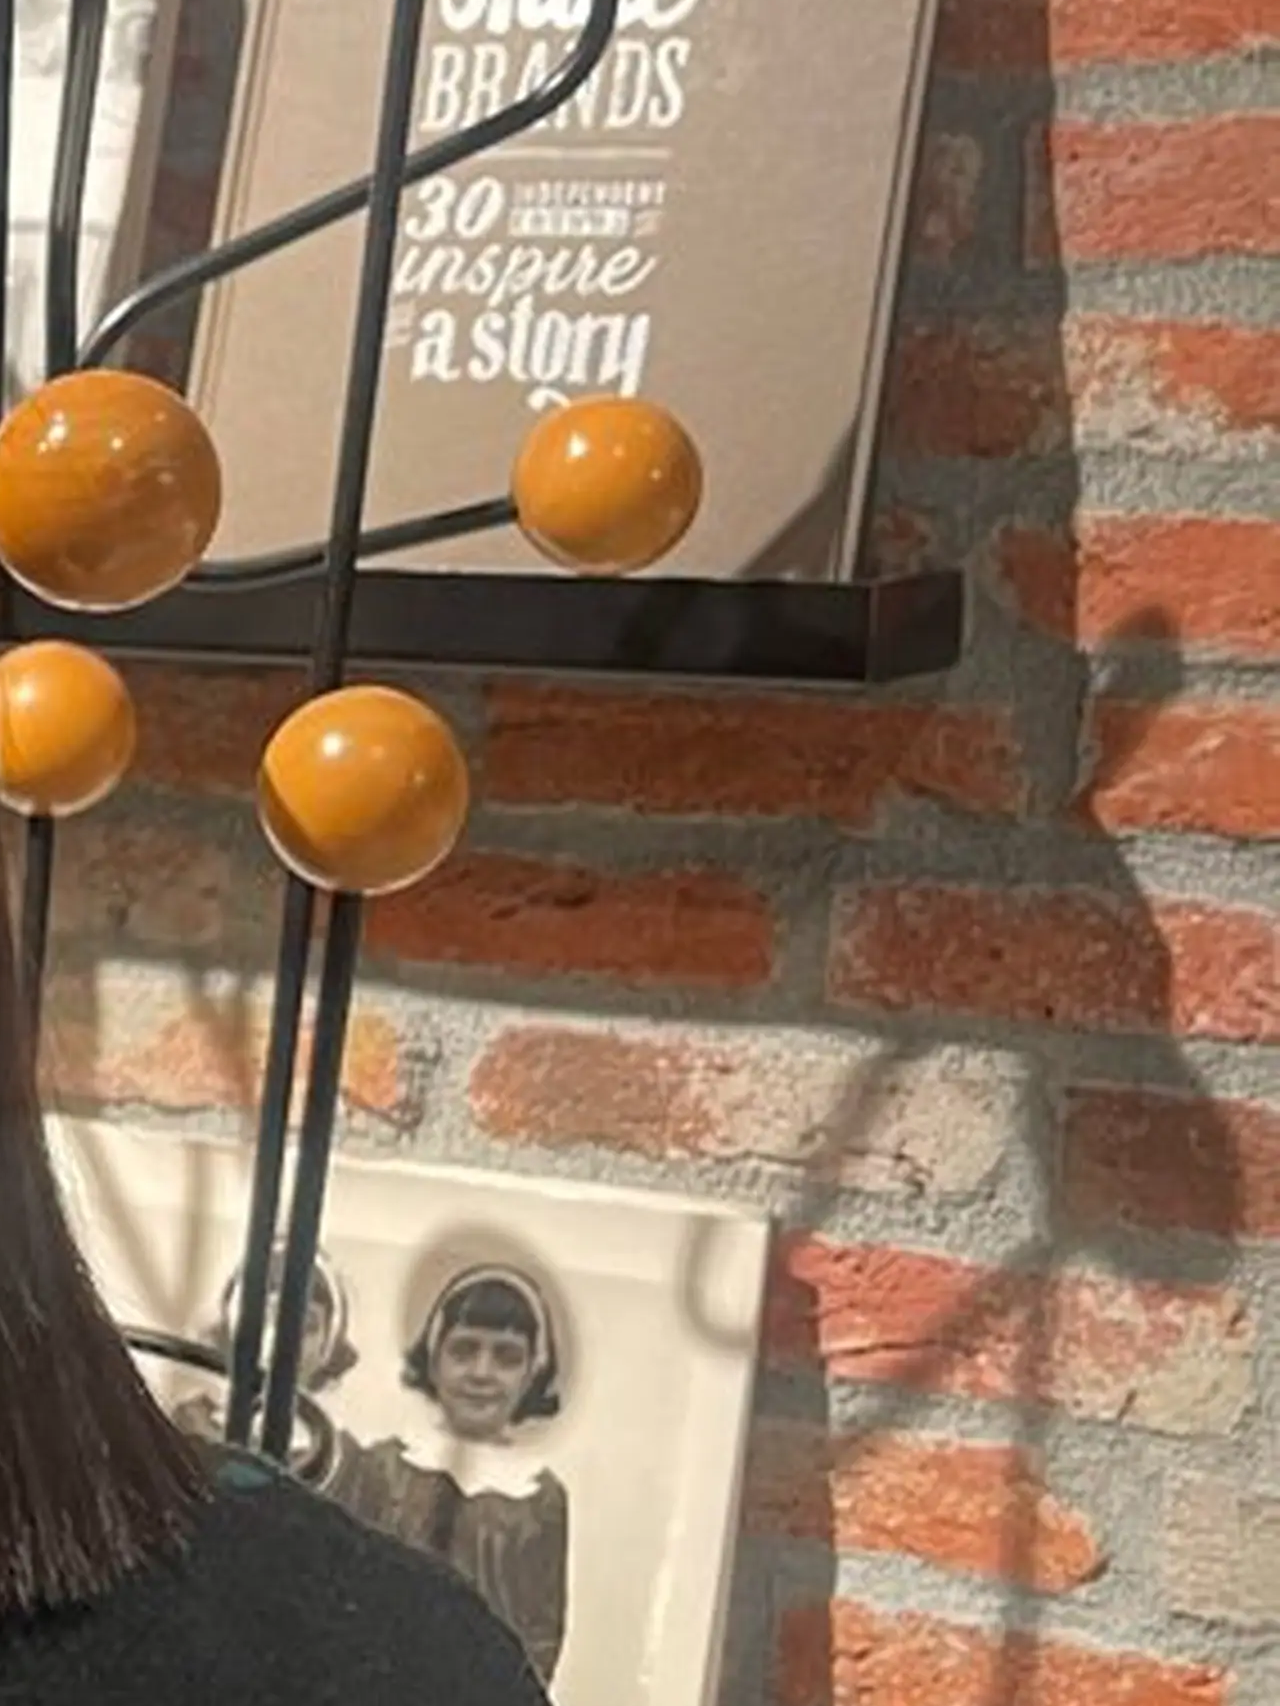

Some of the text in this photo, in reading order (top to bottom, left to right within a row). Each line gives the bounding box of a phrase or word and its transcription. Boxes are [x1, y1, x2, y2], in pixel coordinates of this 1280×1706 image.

[419, 37, 690, 132] BRANDS
[404, 174, 505, 239] 30
[393, 244, 659, 307] inspire
[410, 309, 461, 381] a
[468, 294, 650, 399] story
